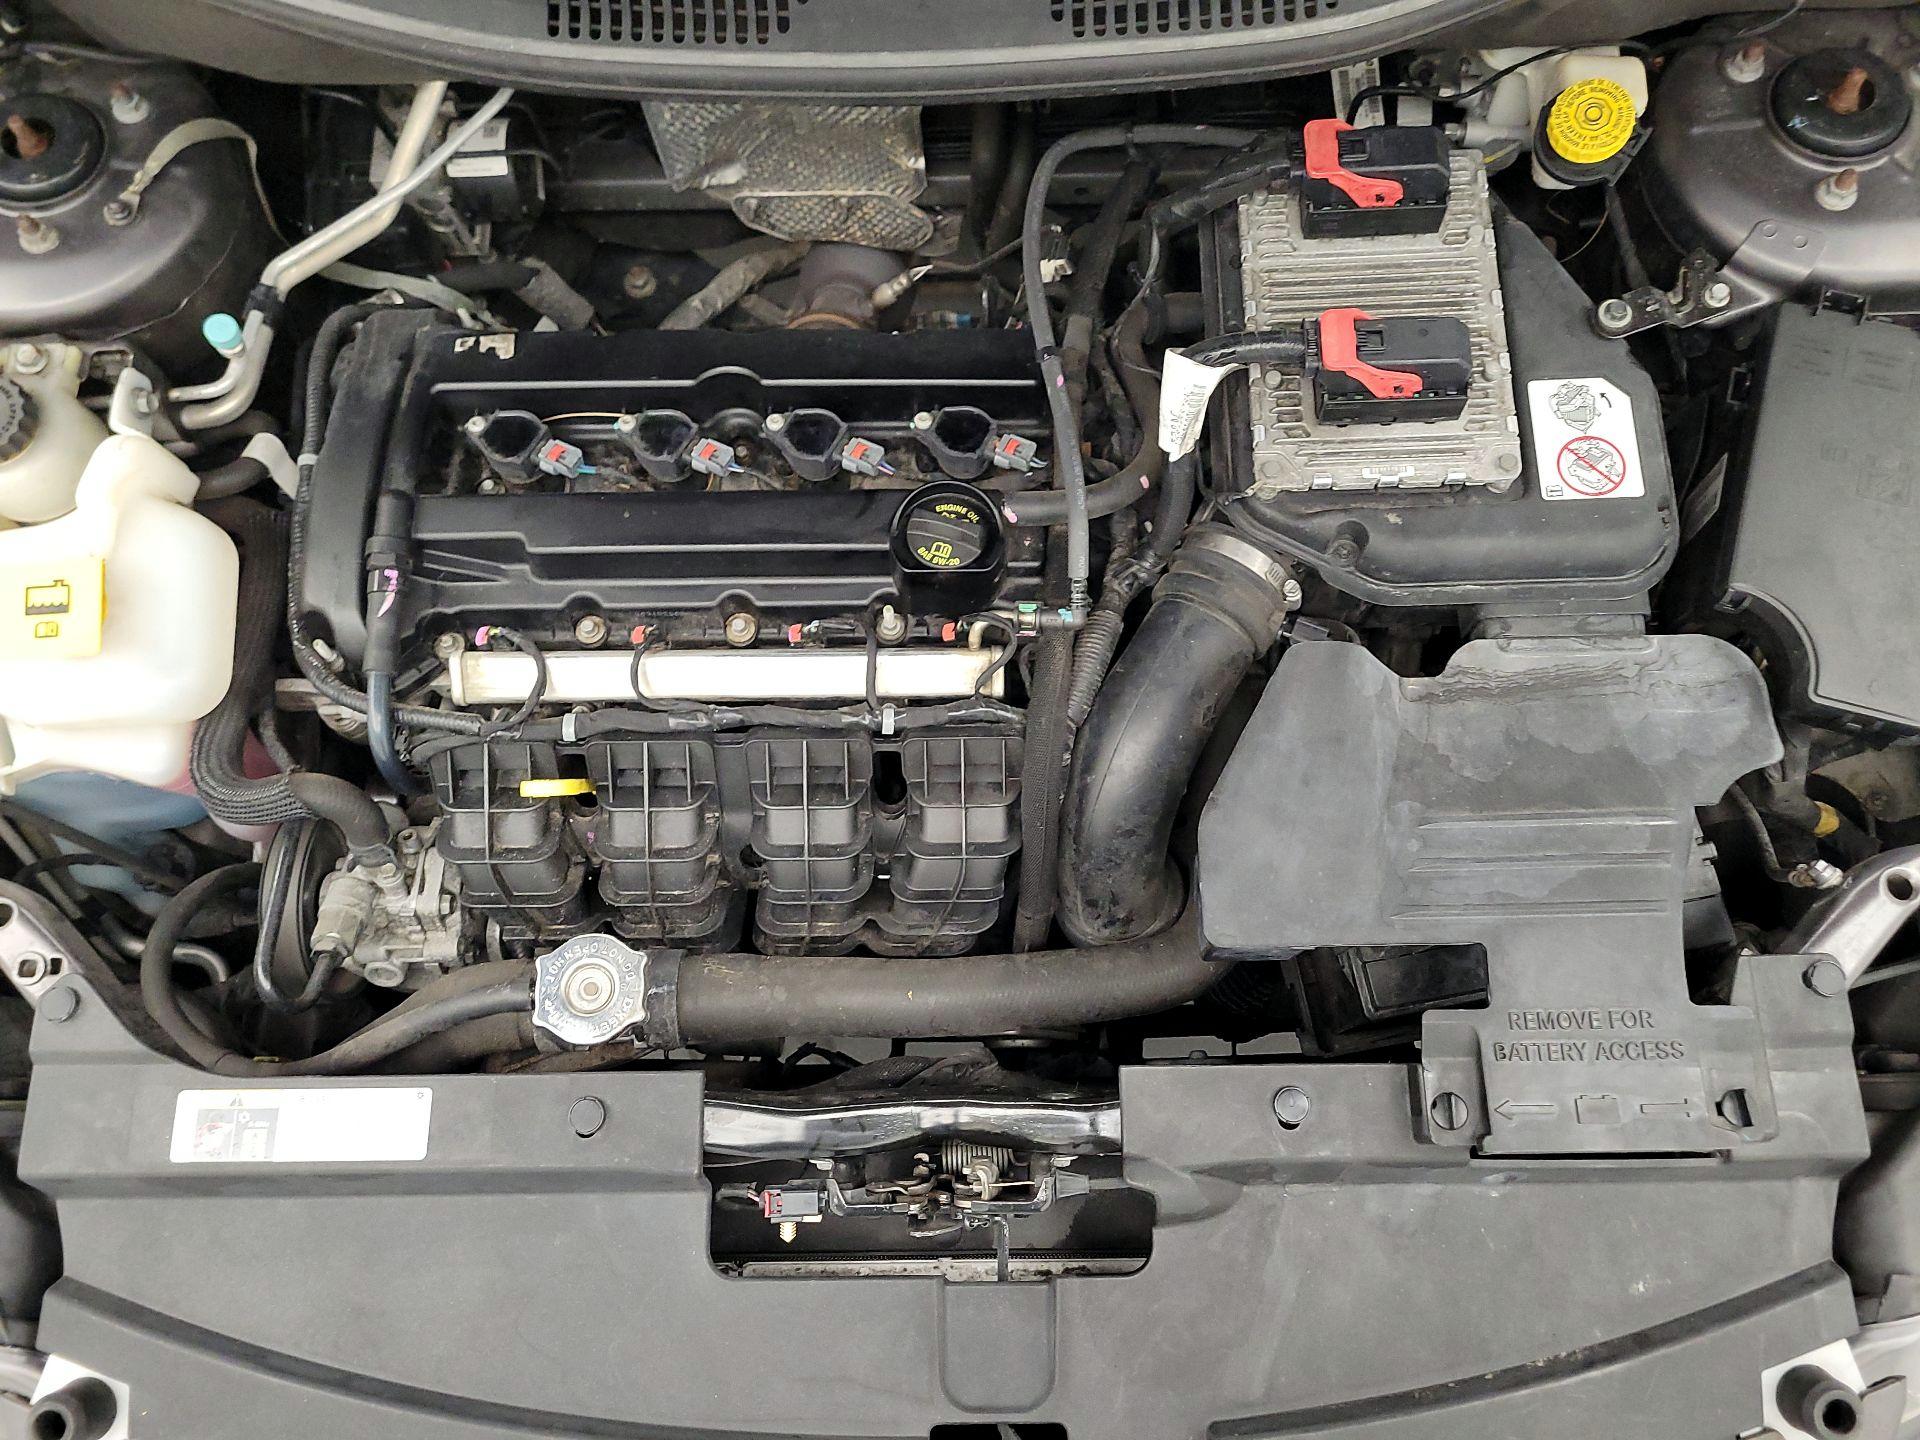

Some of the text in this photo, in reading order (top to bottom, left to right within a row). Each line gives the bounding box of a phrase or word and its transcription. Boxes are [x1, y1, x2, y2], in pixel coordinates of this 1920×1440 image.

[935, 503, 980, 523] ENGINE OIL
[1508, 1009, 1655, 1030] REMOVE FOR
[1493, 1040, 1685, 1062] BATTERY ACCESS
